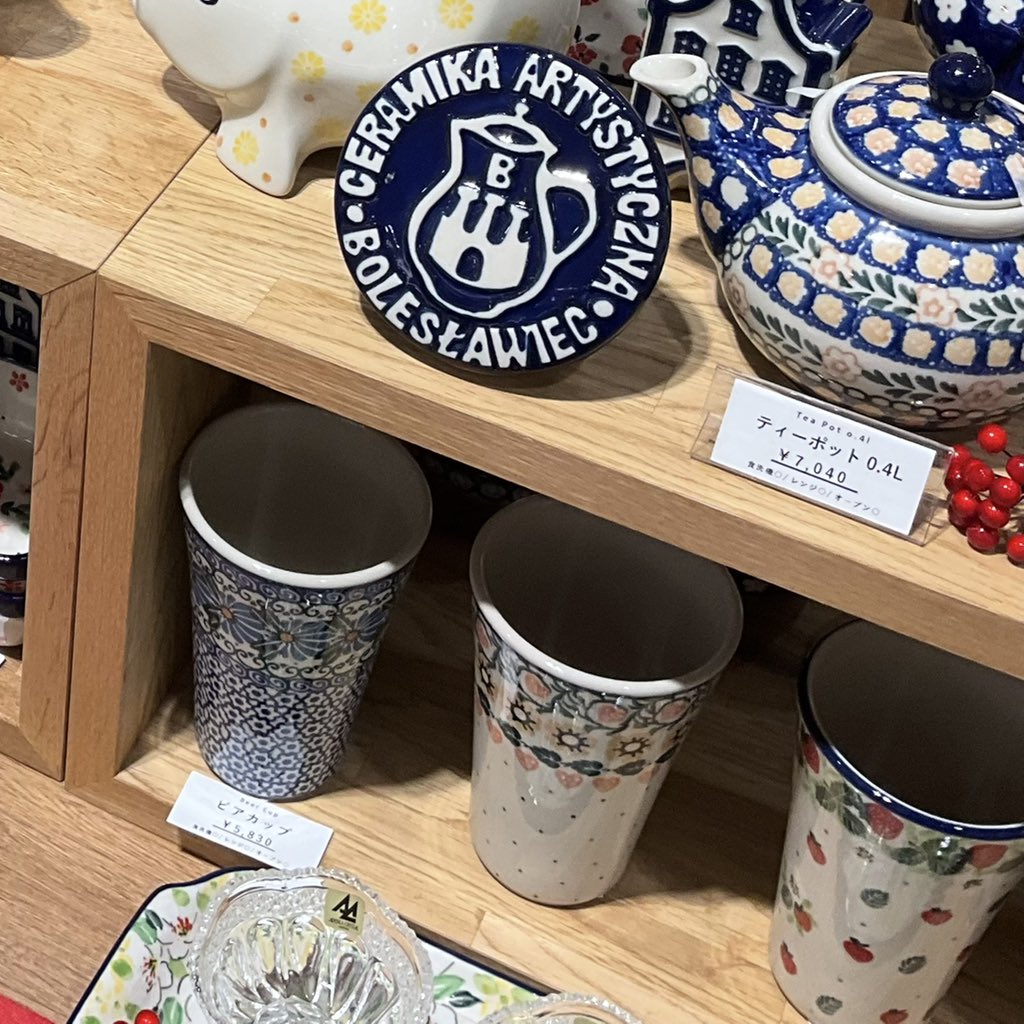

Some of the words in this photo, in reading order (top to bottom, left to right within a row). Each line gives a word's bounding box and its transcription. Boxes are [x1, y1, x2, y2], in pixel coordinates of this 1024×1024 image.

[338, 48, 500, 197] CERAMIKA
[486, 152, 515, 189] B
[513, 53, 660, 302] ARTYSTYCZNA
[343, 227, 598, 369] BOLESŁAWIEC
[757, 415, 860, 464] ティーポット
[866, 456, 904, 482] 0.4L
[796, 411, 816, 425] Tea
[821, 420, 842, 435] Pot
[779, 448, 848, 484] ¥7,040
[223, 820, 273, 847] ¥5,830
